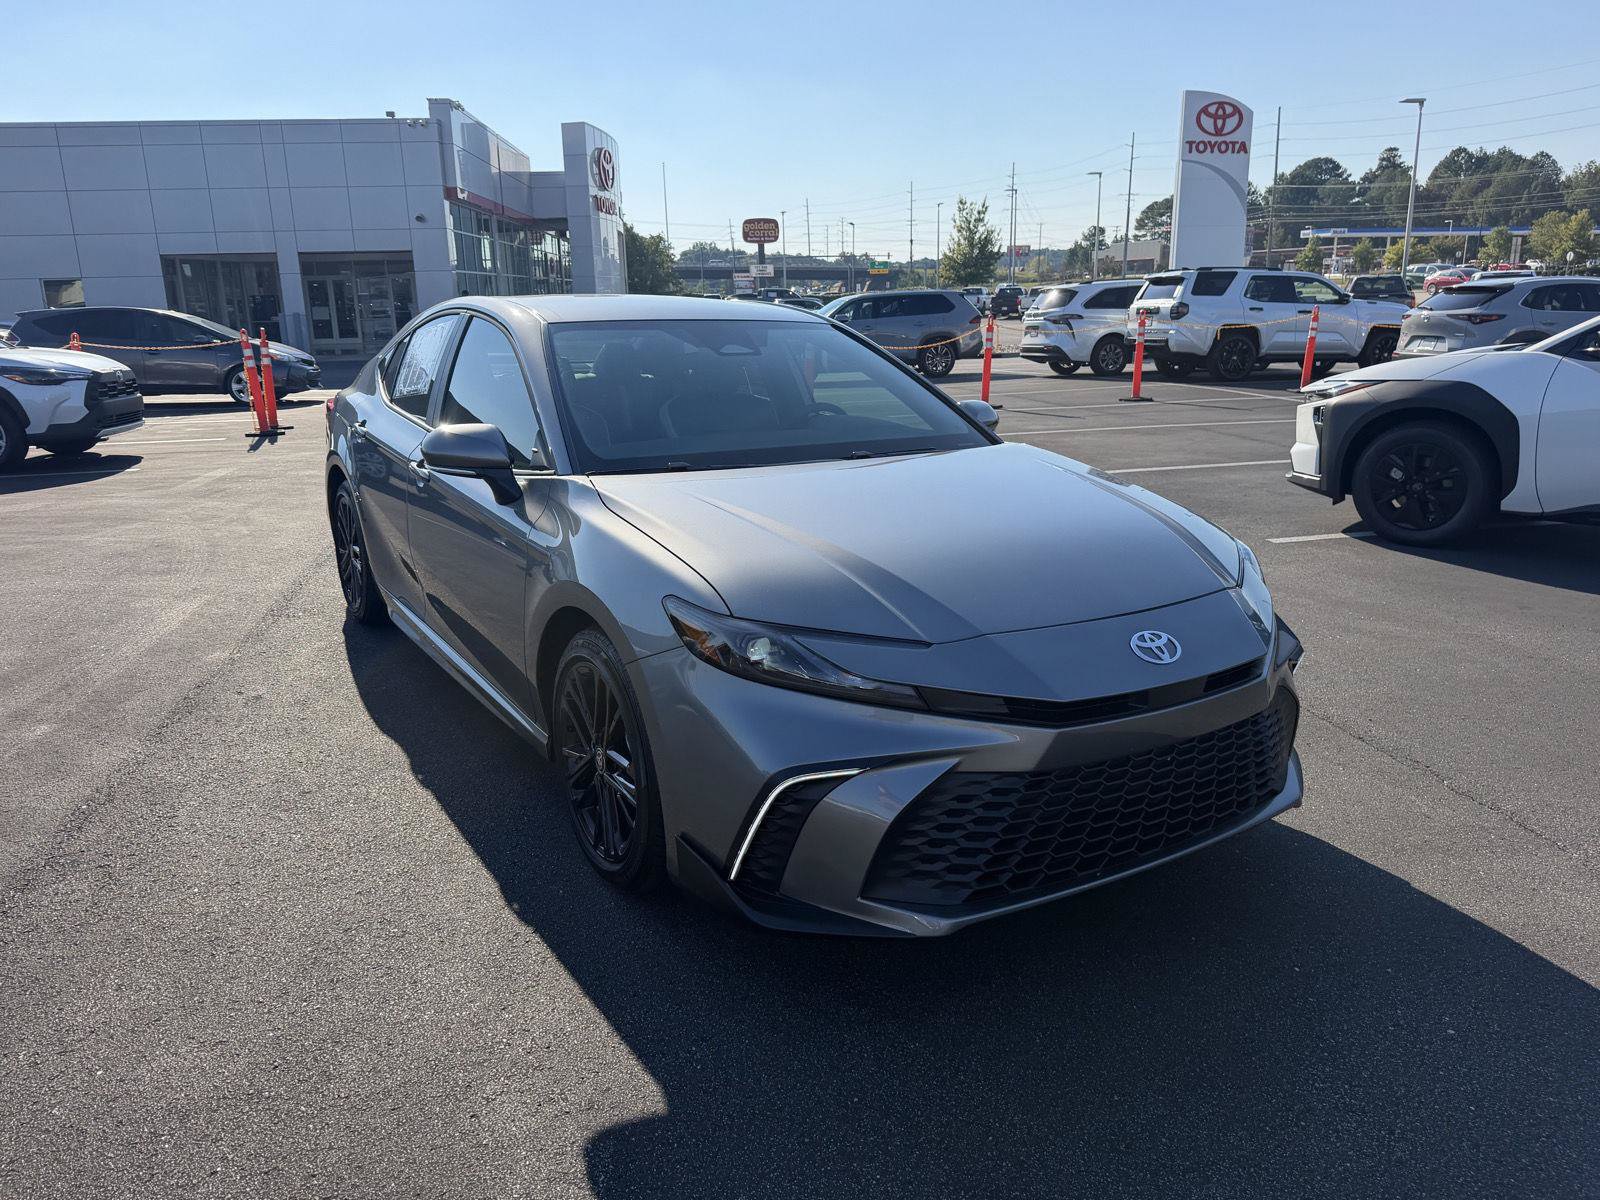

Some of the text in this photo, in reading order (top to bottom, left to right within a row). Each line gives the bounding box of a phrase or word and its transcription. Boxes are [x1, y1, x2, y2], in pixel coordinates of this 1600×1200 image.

[1185, 140, 1248, 154] TOYOTA
[744, 221, 775, 232] golden
[749, 228, 779, 237] corral
